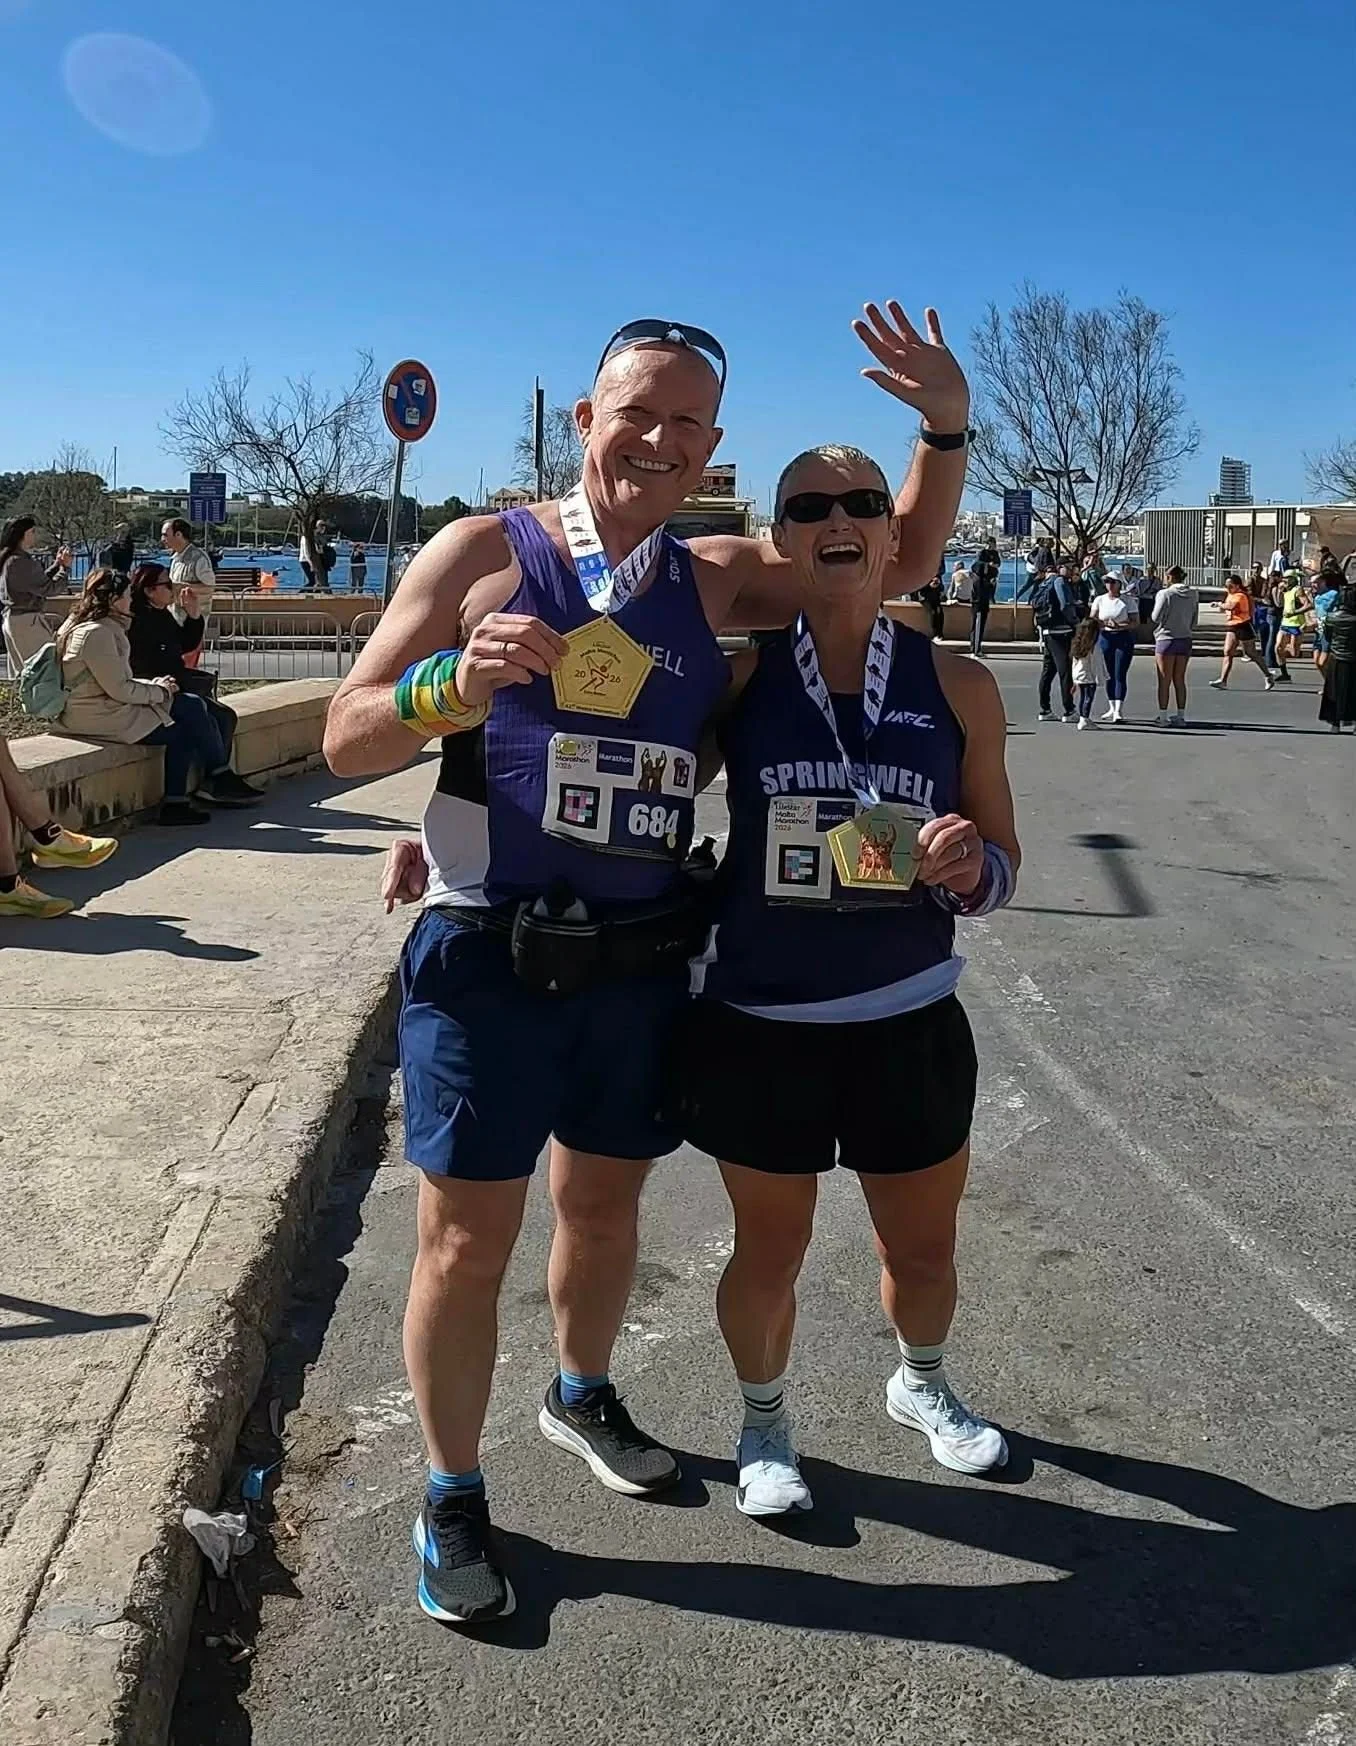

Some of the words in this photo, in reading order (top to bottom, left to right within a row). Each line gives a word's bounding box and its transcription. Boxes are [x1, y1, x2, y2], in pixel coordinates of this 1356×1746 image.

[574, 669, 586, 679] 20
[608, 674, 622, 684] 26
[554, 754, 591, 765] Marathon
[598, 752, 633, 765] Marathon
[774, 810, 796, 819] Malta
[773, 817, 810, 826] Marathon
